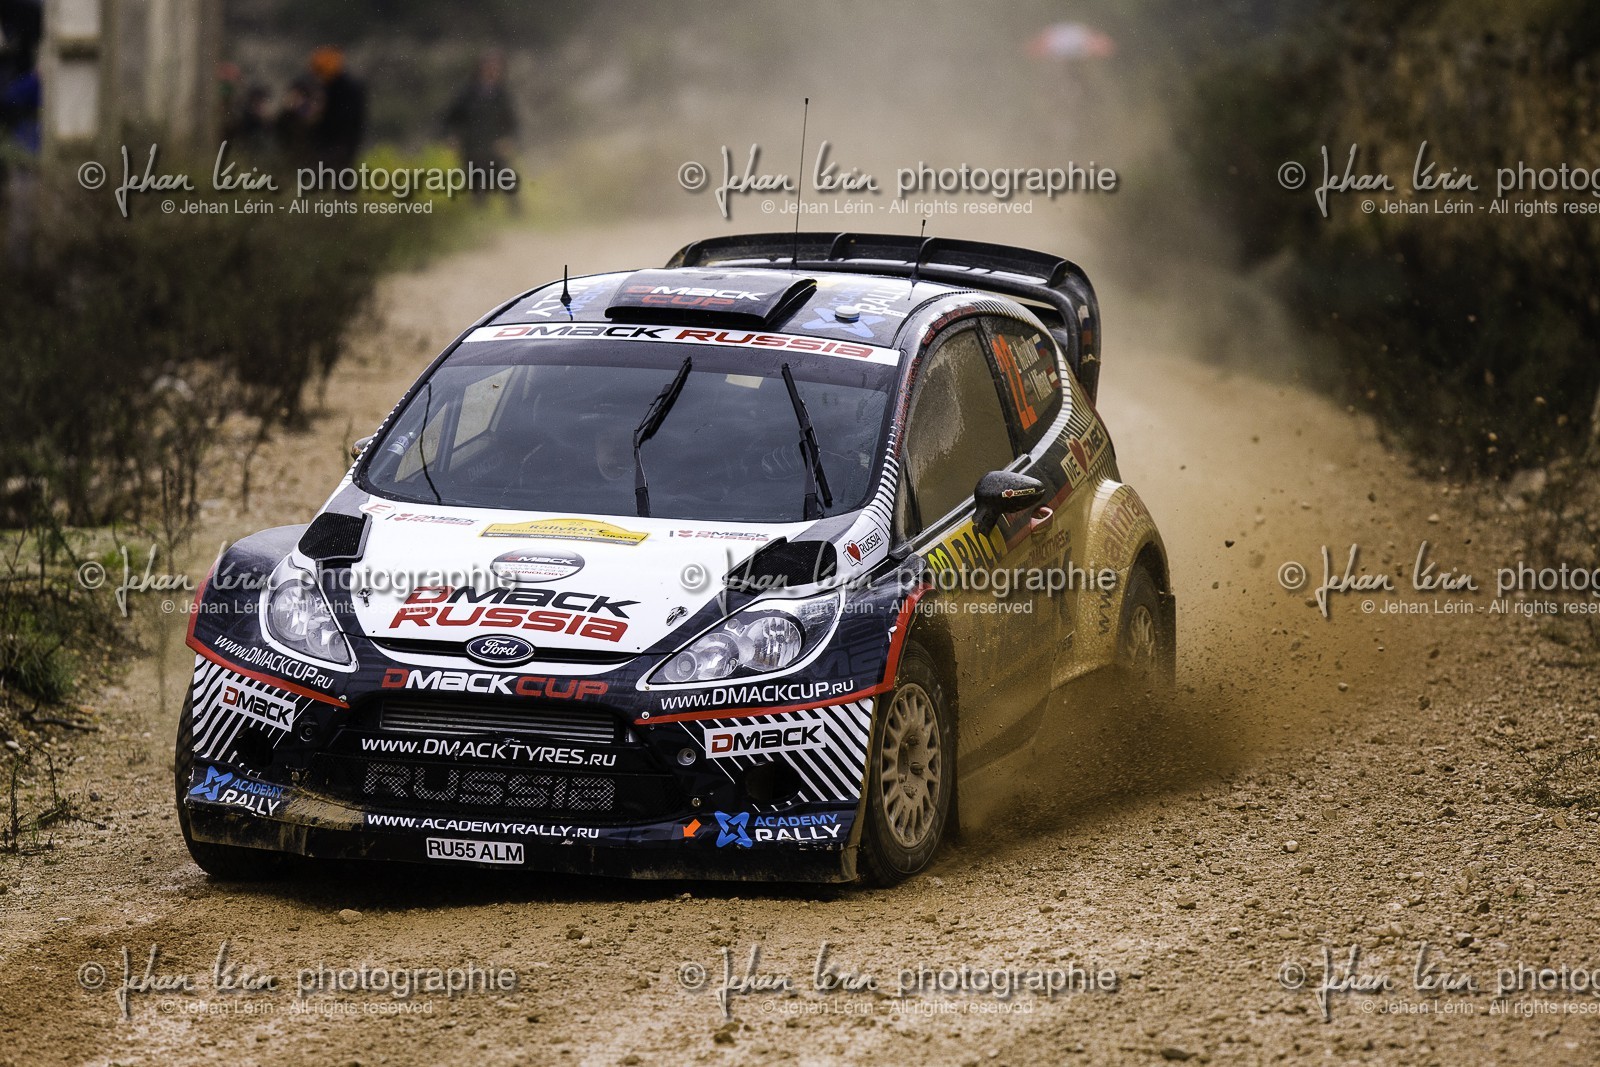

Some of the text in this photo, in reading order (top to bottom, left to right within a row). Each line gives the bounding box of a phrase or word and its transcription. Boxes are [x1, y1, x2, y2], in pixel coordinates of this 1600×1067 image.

[641, 294, 736, 307] CUP
[675, 329, 874, 359] RUSSIA
[858, 533, 883, 555] RUSSIA
[388, 606, 629, 643] RUSSIA
[480, 639, 517, 657] Ford
[230, 778, 283, 799] ACADEMY
[362, 761, 616, 812] RUSSIA
[219, 788, 281, 817] RALLY
[754, 813, 839, 827] ACADEMY
[755, 824, 842, 842] RALLY
[427, 839, 523, 862] RU55 ALM
